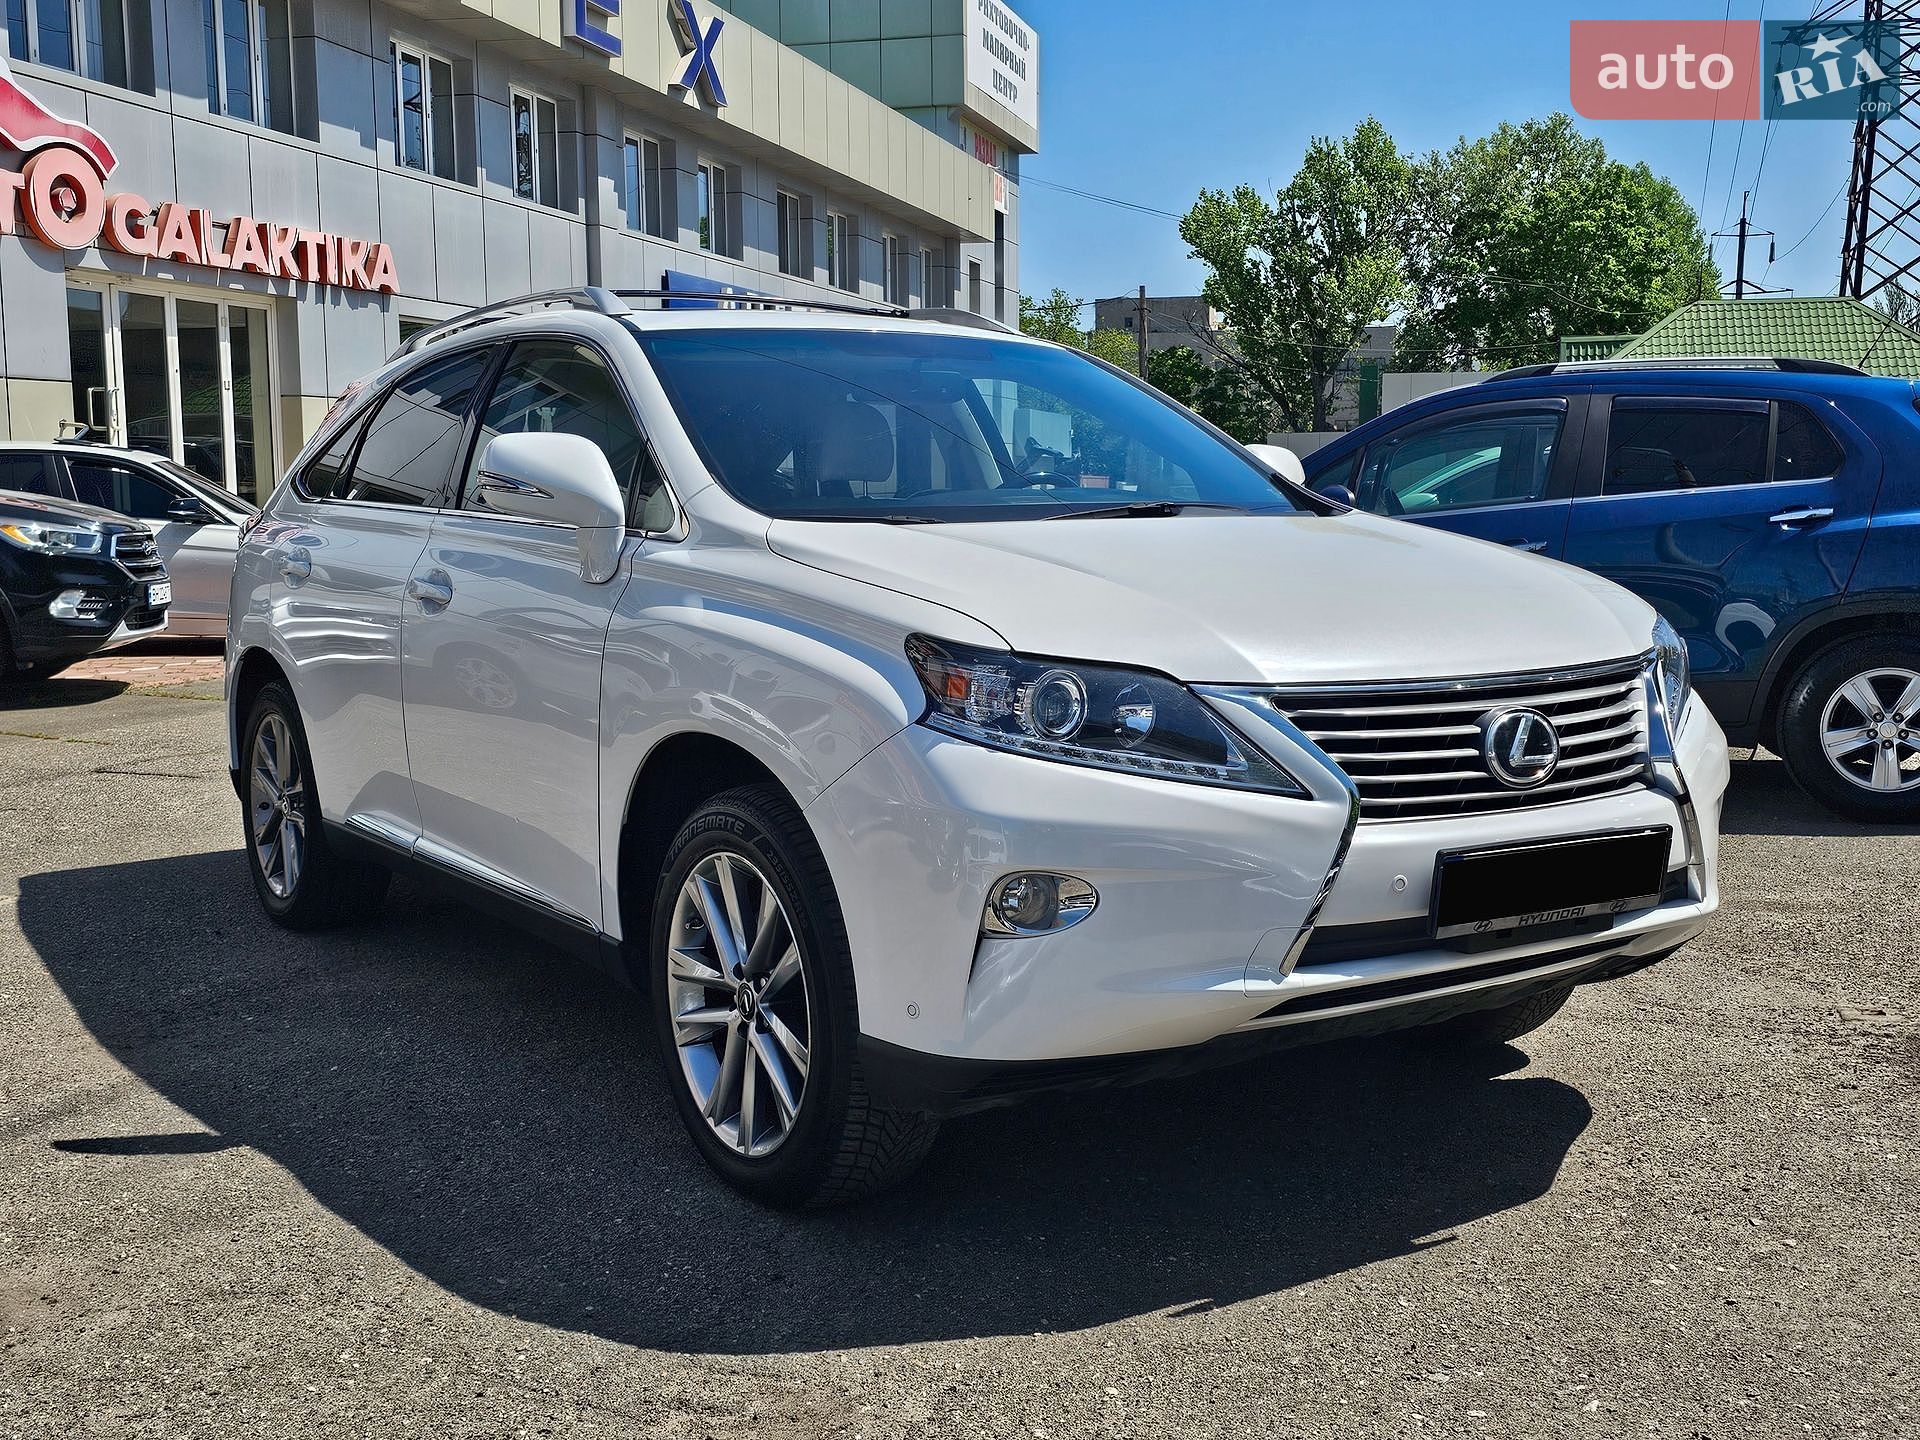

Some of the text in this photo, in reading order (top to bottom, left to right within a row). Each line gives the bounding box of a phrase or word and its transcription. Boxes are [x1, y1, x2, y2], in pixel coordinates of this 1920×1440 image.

[982, 27, 1026, 82] МАЛЯРНЫЙ
[992, 68, 1018, 104] ЦЕНТР
[667, 814, 746, 864] TRANSMATE
[1518, 906, 1586, 927] HYUNDAI
